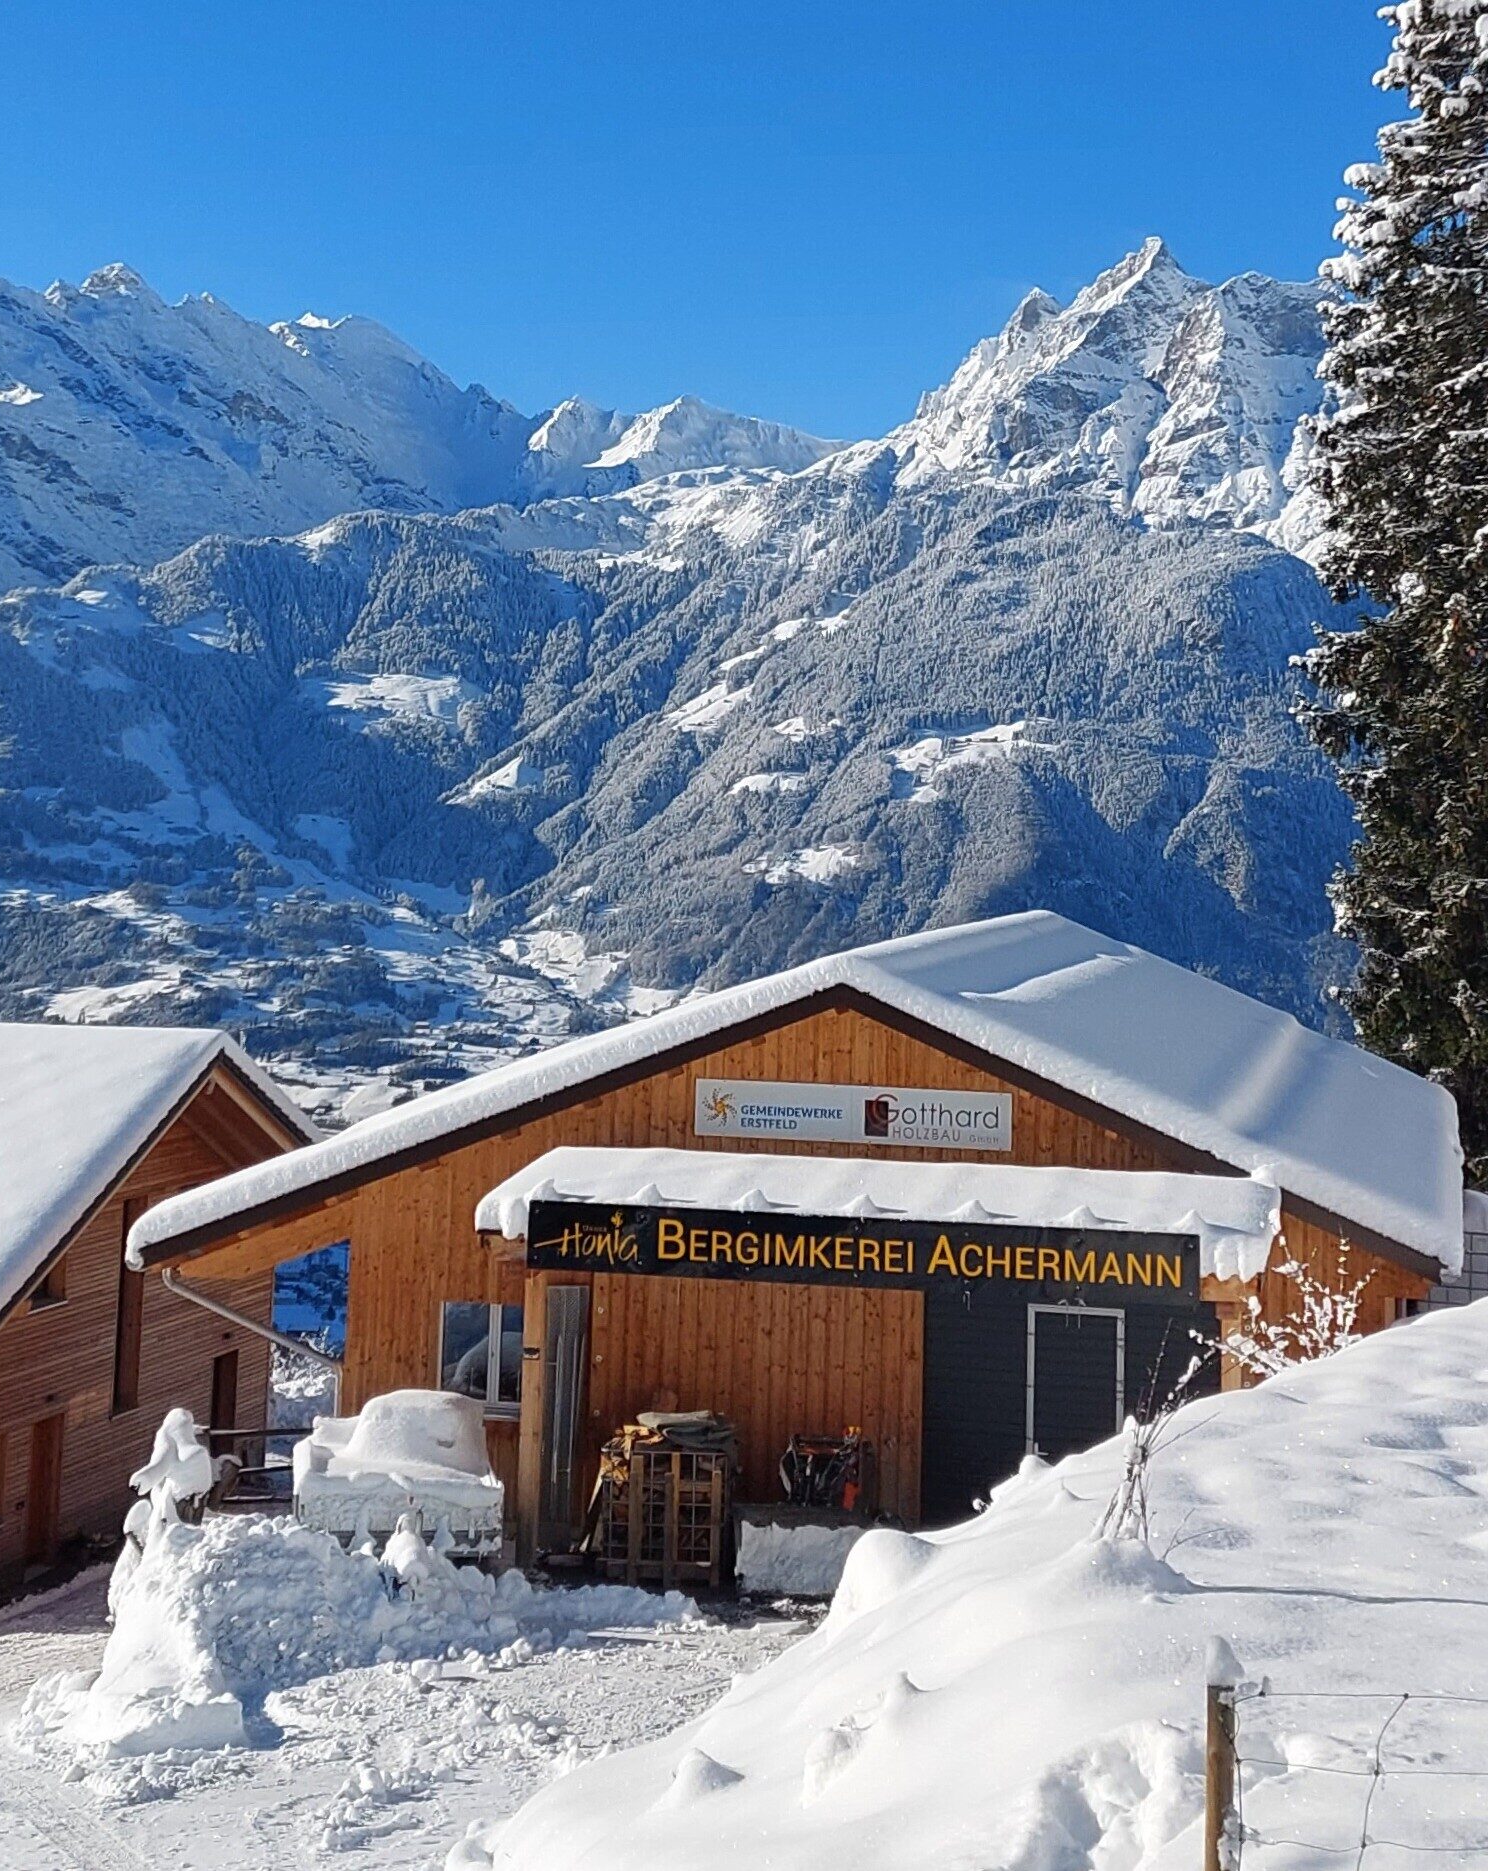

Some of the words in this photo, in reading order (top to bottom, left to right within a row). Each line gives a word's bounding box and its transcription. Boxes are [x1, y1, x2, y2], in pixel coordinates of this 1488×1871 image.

[740, 1105, 843, 1120] GEMEINDEWERKE
[870, 1093, 1000, 1129] Gotthard
[740, 1117, 798, 1130] ERSTFELD
[892, 1127, 961, 1142] HOLZBAU
[657, 1218, 914, 1274] BERGIMKEREI
[926, 1234, 1182, 1288] ACHERMANN
